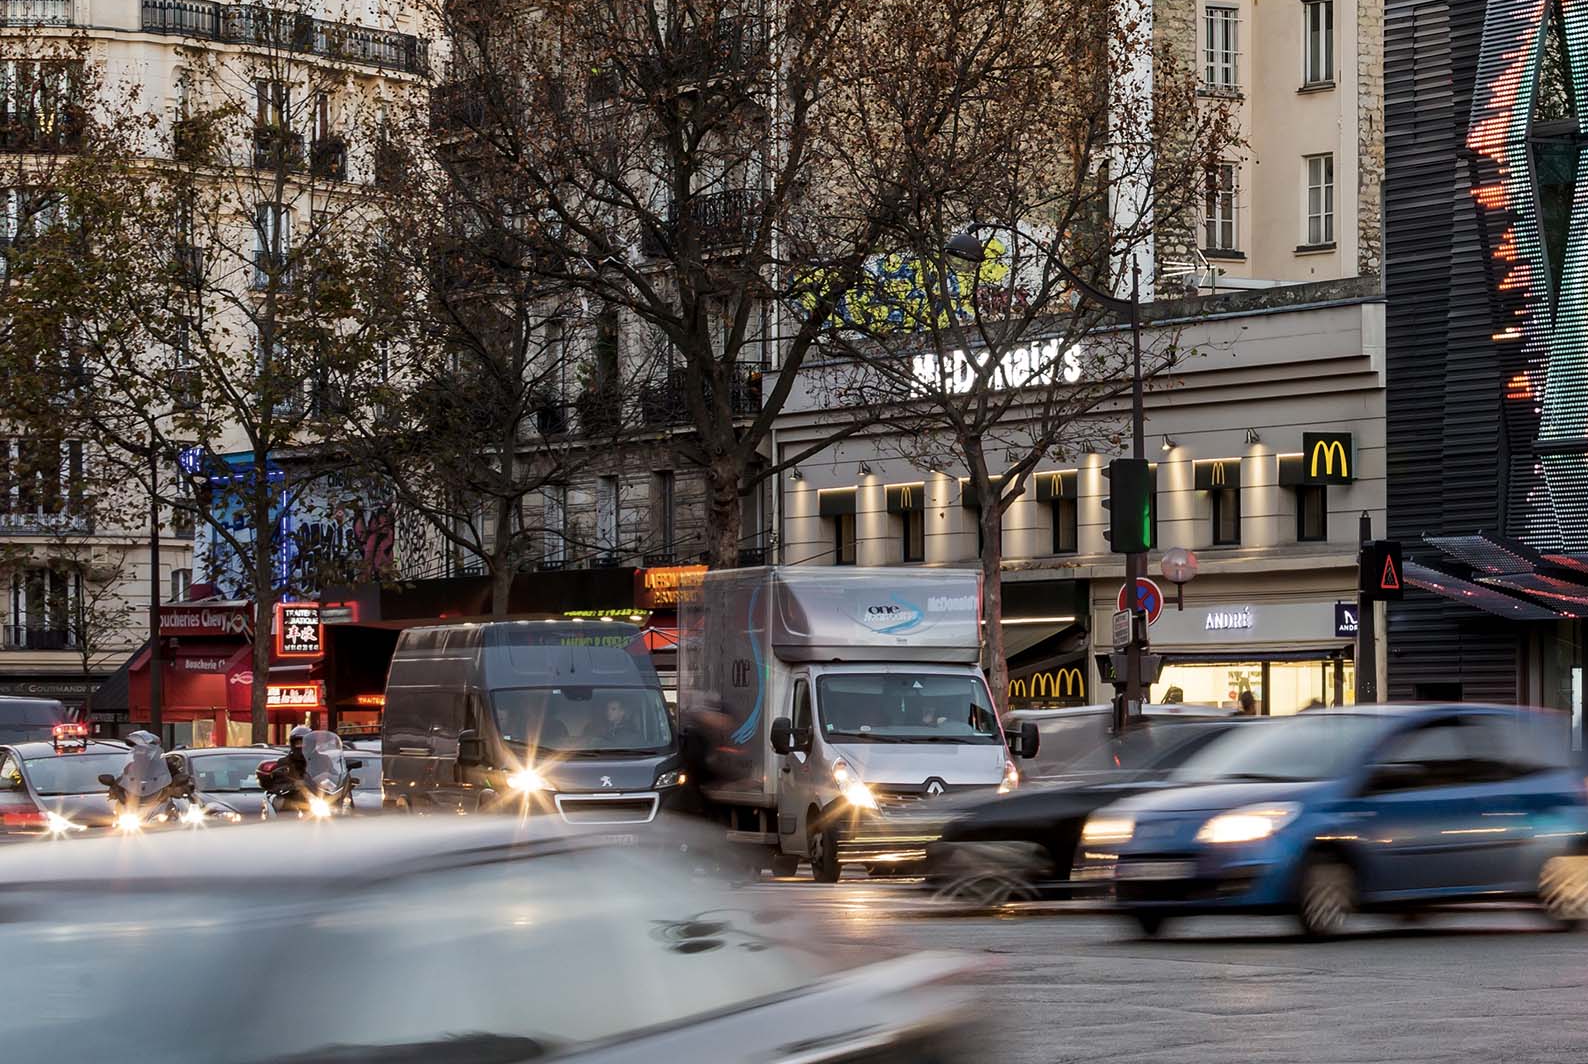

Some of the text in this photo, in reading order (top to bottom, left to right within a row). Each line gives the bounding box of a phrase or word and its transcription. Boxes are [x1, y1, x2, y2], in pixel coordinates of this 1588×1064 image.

[867, 605, 900, 615] one
[1205, 606, 1254, 630] ANDRÉ
[160, 612, 199, 628] oucheries
